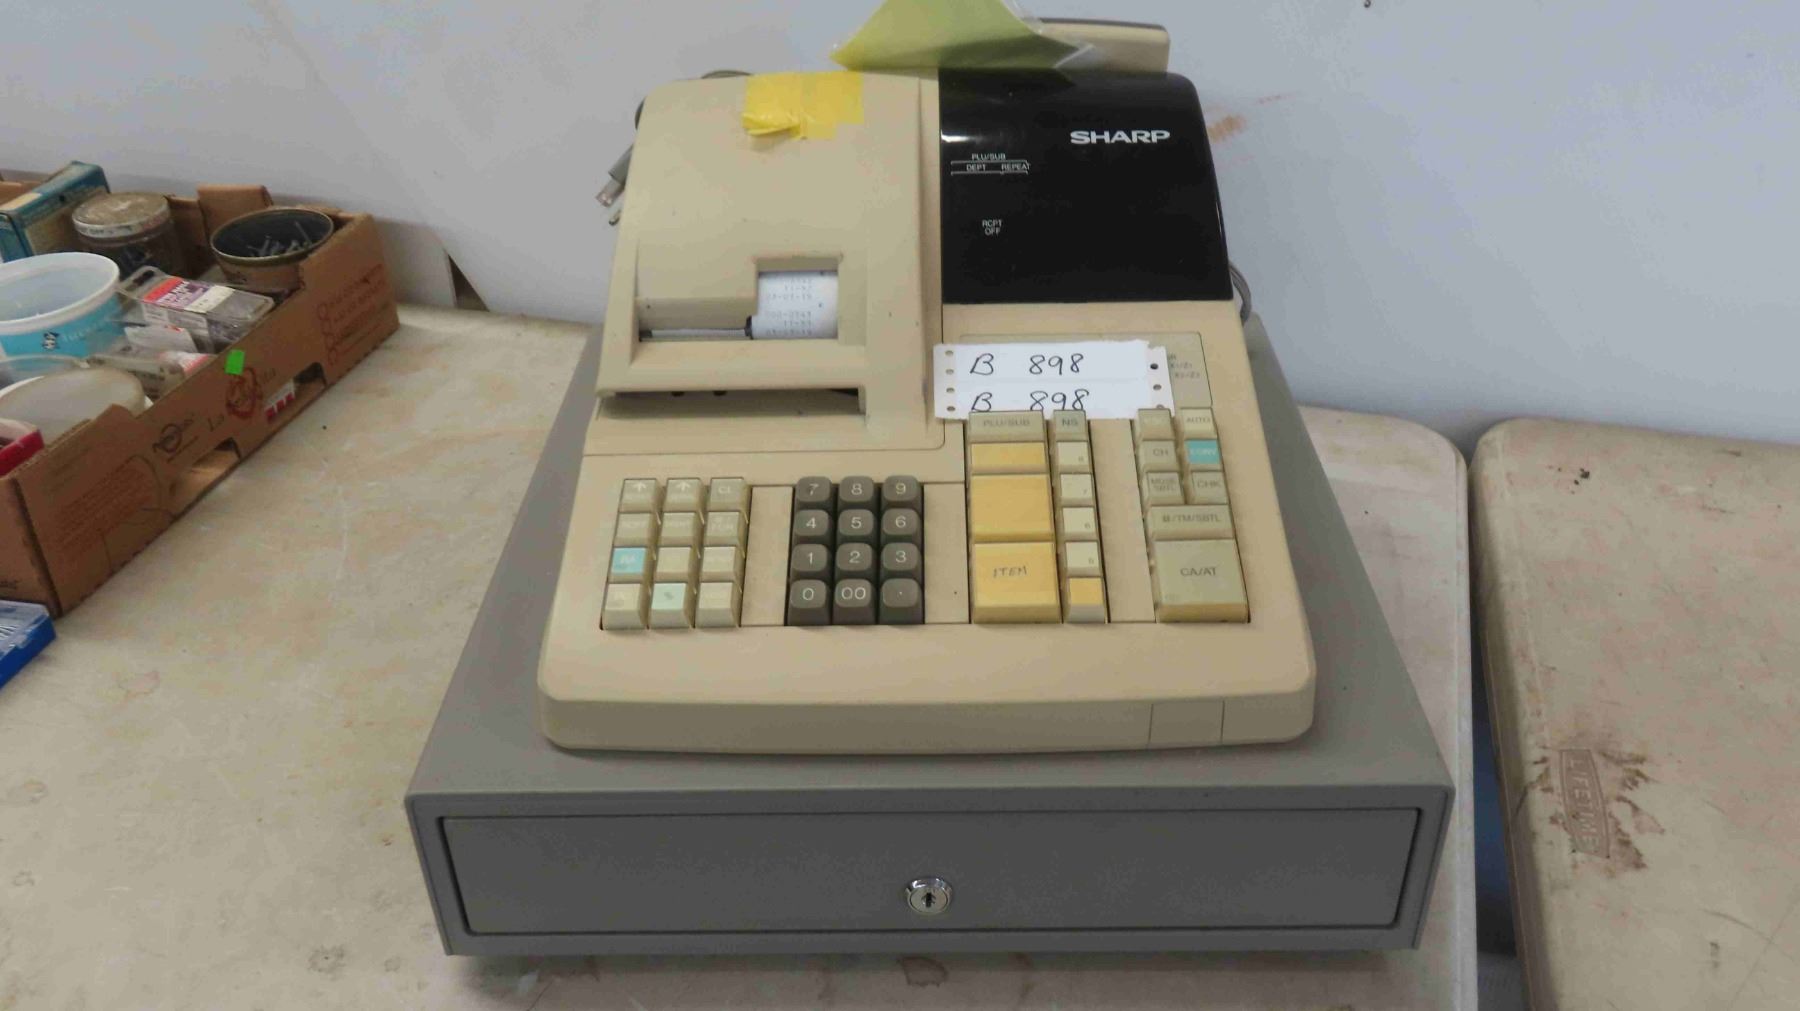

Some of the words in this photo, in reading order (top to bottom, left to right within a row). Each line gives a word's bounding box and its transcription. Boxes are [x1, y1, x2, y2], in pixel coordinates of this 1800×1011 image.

[1070, 130, 1170, 144] SHARP
[982, 219, 1003, 227] RCPT
[985, 228, 1001, 236] OFF
[970, 352, 995, 376] B
[1028, 352, 1085, 376] 898
[971, 391, 993, 413] B
[1029, 388, 1090, 412] 898
[1061, 418, 1079, 427] NS
[1152, 448, 1169, 457] CH
[809, 483, 820, 496] 7
[850, 483, 863, 495] 8
[895, 482, 907, 495] 9
[1197, 479, 1222, 489] CHK
[806, 517, 817, 529] 4
[850, 516, 862, 529] 5
[895, 516, 907, 528] 6
[807, 552, 814, 565] 1
[849, 550, 861, 563] 2
[895, 550, 907, 563] 3
[991, 565, 1028, 579] ITEM
[1180, 567, 1218, 577] CA/AT
[802, 588, 815, 600] 0
[841, 586, 867, 600] 00
